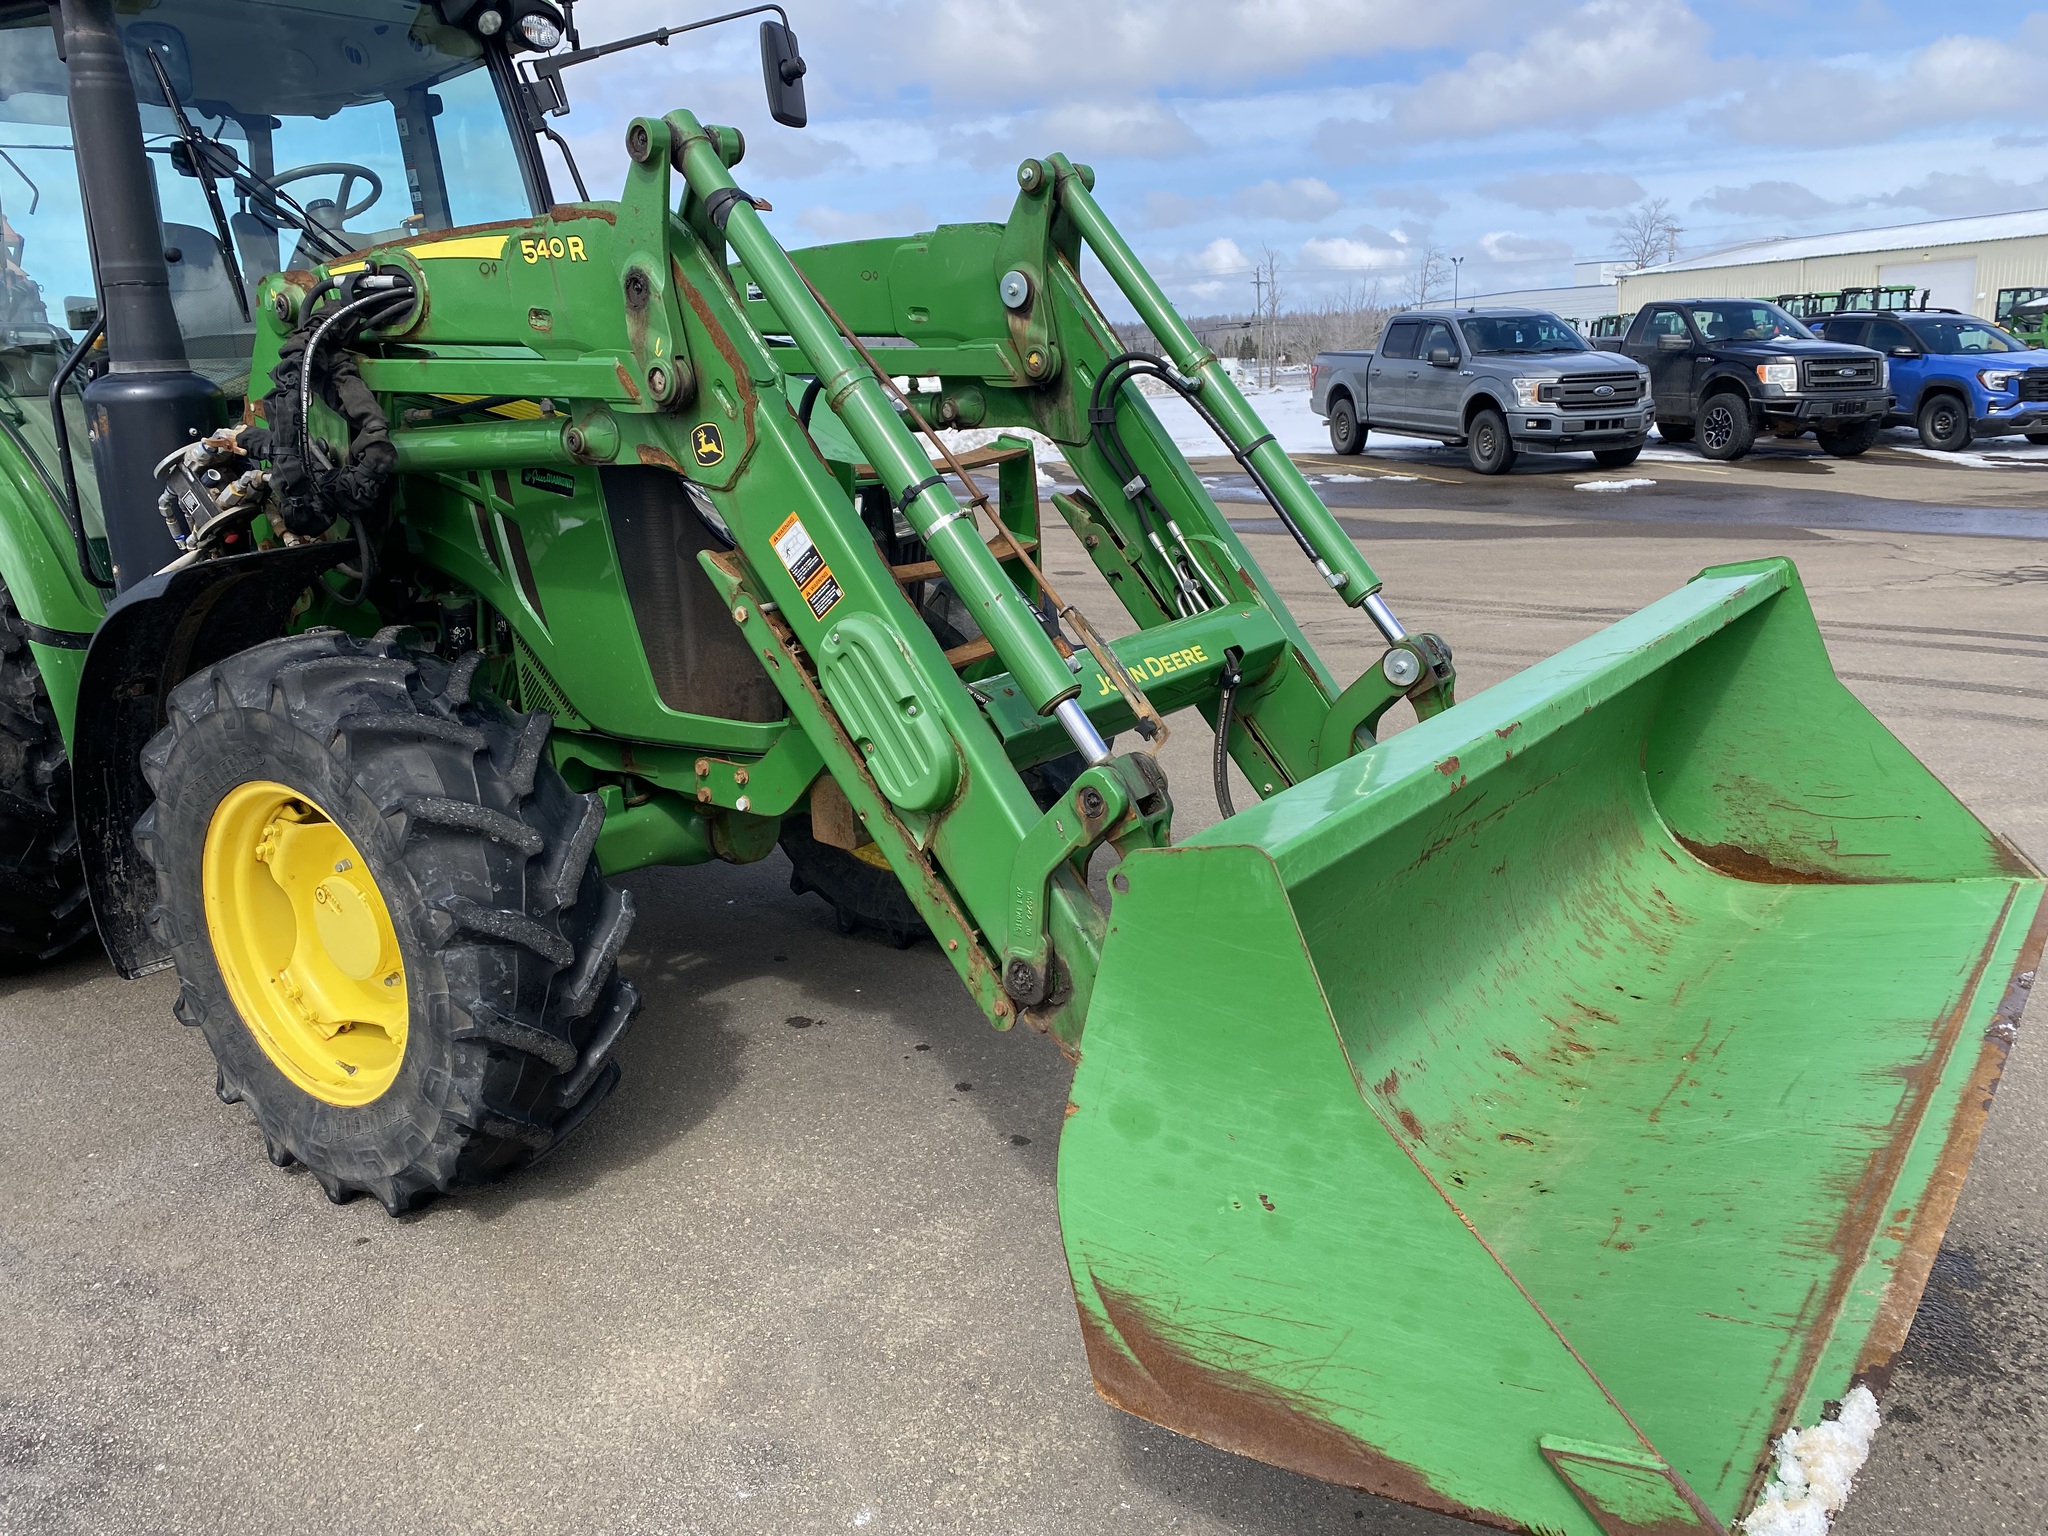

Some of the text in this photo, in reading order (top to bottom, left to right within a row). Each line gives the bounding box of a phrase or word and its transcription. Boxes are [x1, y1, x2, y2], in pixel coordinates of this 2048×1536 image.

[777, 516, 795, 538] WARNING
[810, 571, 829, 592] WARNING
[1096, 645, 1208, 696] JN DEERE
